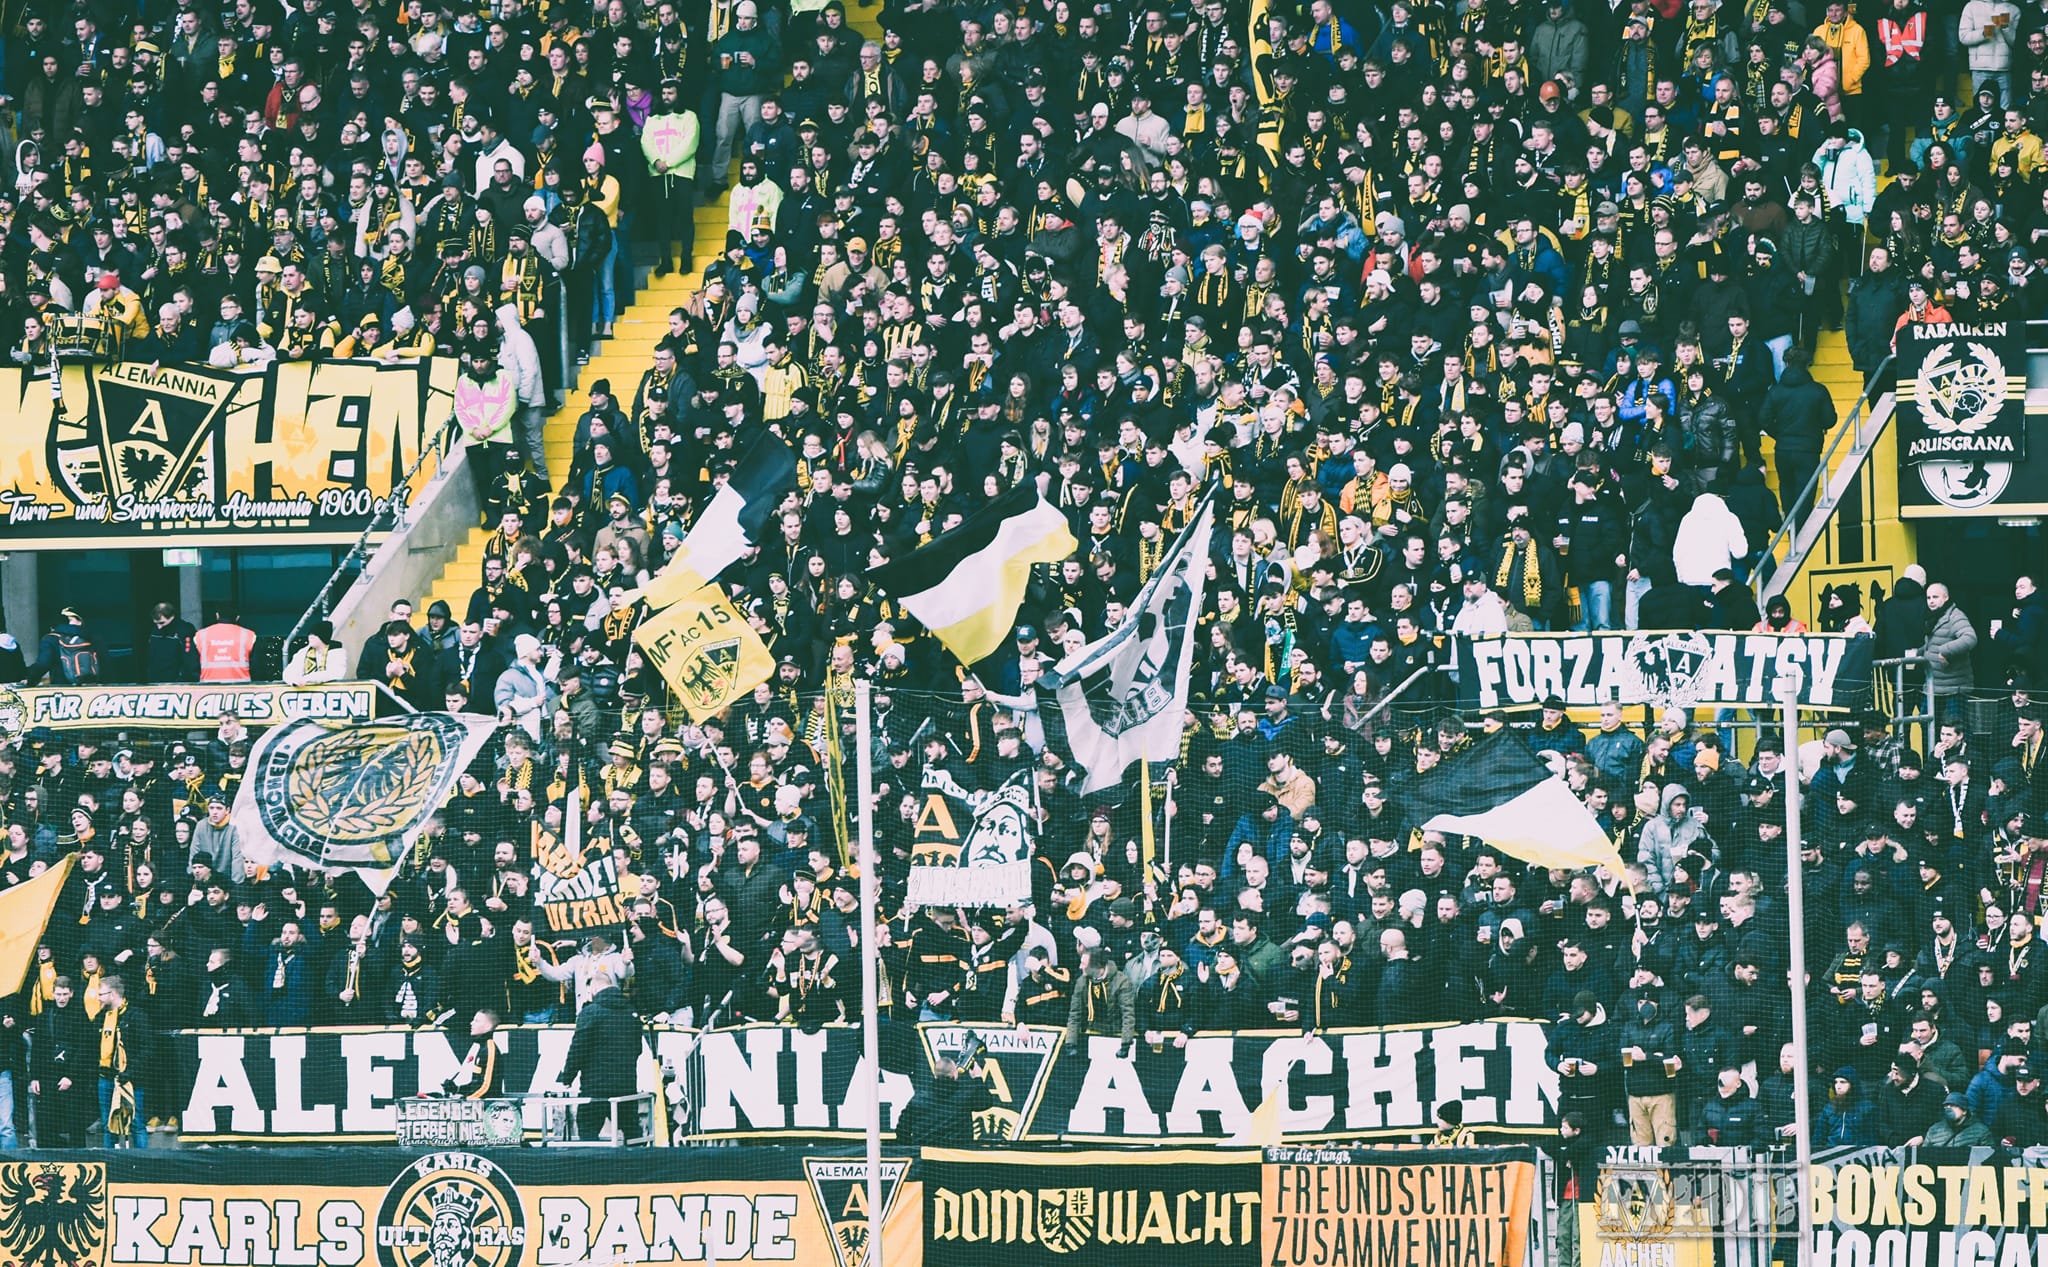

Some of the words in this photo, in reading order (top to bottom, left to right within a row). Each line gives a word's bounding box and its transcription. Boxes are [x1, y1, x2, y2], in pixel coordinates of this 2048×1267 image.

[100, 359, 218, 399] ALEMANNIA
[129, 398, 169, 441] A
[1908, 436, 2014, 457] AQUISGRANA
[75, 495, 107, 521] und
[221, 491, 312, 518] Alemannia
[1473, 637, 1628, 708] FORZA
[1675, 653, 1691, 673] A
[34, 693, 81, 721] FÜR
[195, 694, 272, 719] ALLES
[279, 693, 369, 718] GEBEN!
[914, 794, 959, 838] A
[544, 896, 626, 932] ULTRAS
[1067, 1022, 1562, 1136] AACHEN
[396, 1102, 484, 1120] LEGENDEN
[396, 1121, 455, 1140] STERBEN
[414, 1154, 493, 1178] KARLS
[815, 1166, 898, 1178] ALEMAIA
[1277, 1164, 1507, 1216] FREUNDSCHAFT
[112, 1198, 364, 1266] KARLS
[379, 1226, 425, 1246] ULT
[479, 1226, 525, 1246] RAS
[537, 1195, 798, 1265] BANDE
[1271, 1217, 1510, 1267] ZUSAMMENHALT
[1798, 1230, 2048, 1267] HOOLIGA
